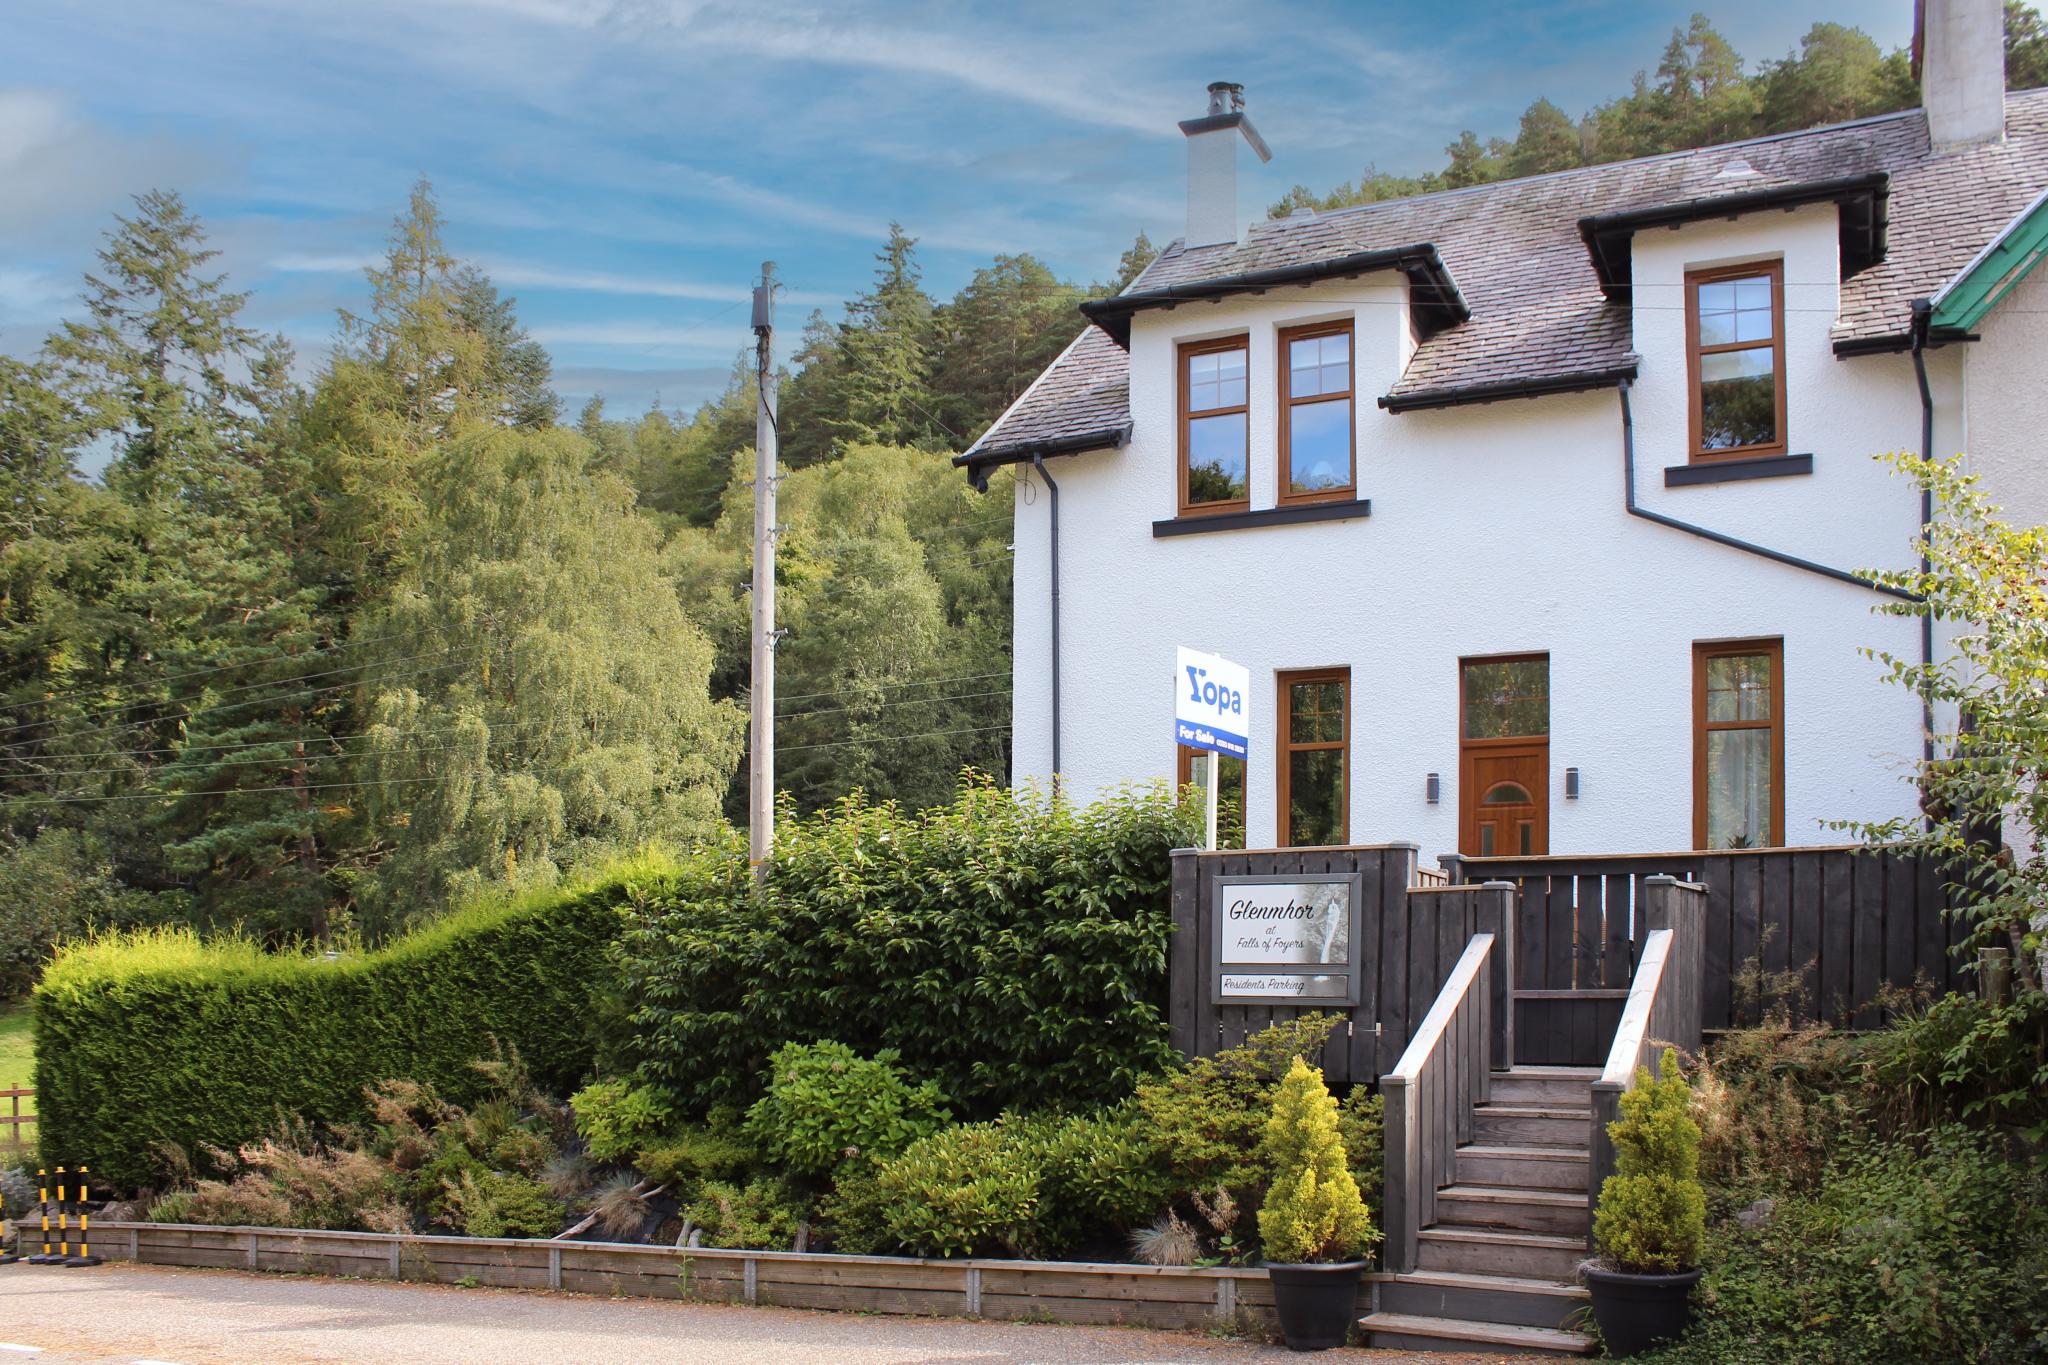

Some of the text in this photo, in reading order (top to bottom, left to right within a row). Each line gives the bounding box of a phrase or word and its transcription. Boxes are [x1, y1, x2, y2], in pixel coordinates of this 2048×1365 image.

[1186, 665, 1241, 715] Yopa
[1180, 725, 1214, 745] For Sale
[1230, 899, 1314, 919] Glenmhor
[1265, 926, 1276, 935] at
[1237, 937, 1304, 953] Falls of Foyers
[1224, 978, 1304, 995] Residents Parking
